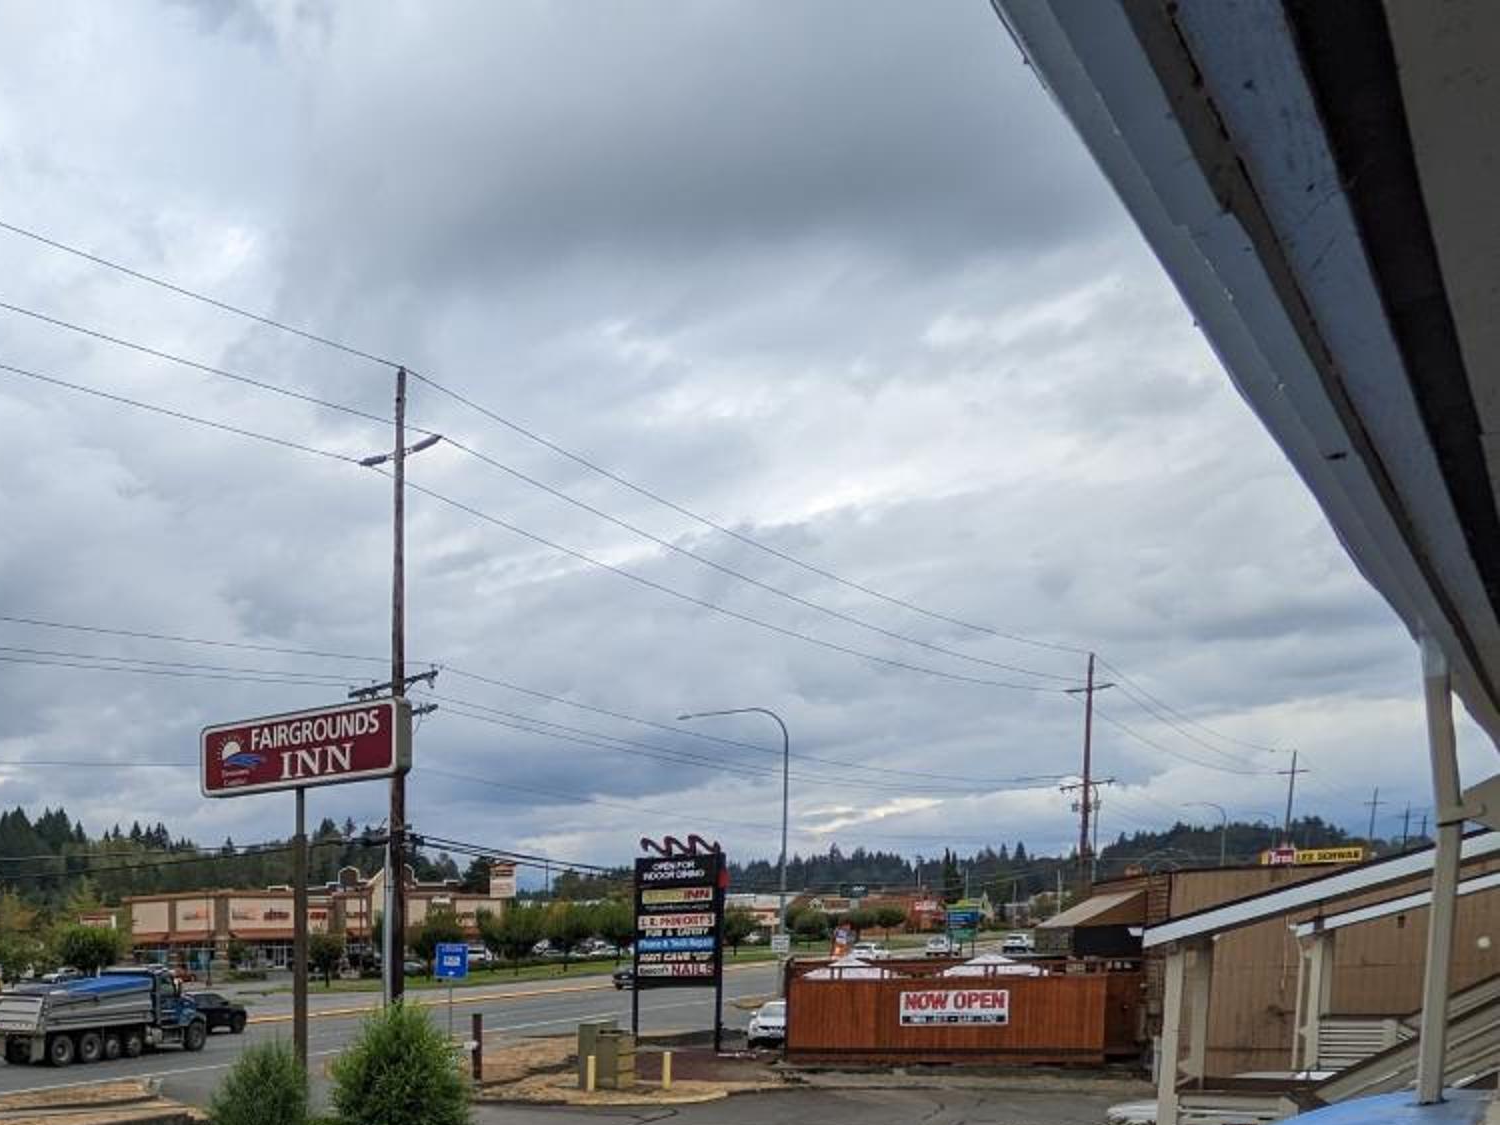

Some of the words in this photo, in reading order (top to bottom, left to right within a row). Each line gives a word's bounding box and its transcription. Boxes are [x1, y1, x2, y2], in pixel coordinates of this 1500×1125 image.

[251, 709, 379, 751] FAIRGROUNDS
[280, 742, 354, 779] INN
[905, 993, 949, 1010] NOW
[954, 992, 1005, 1009] OPEN
